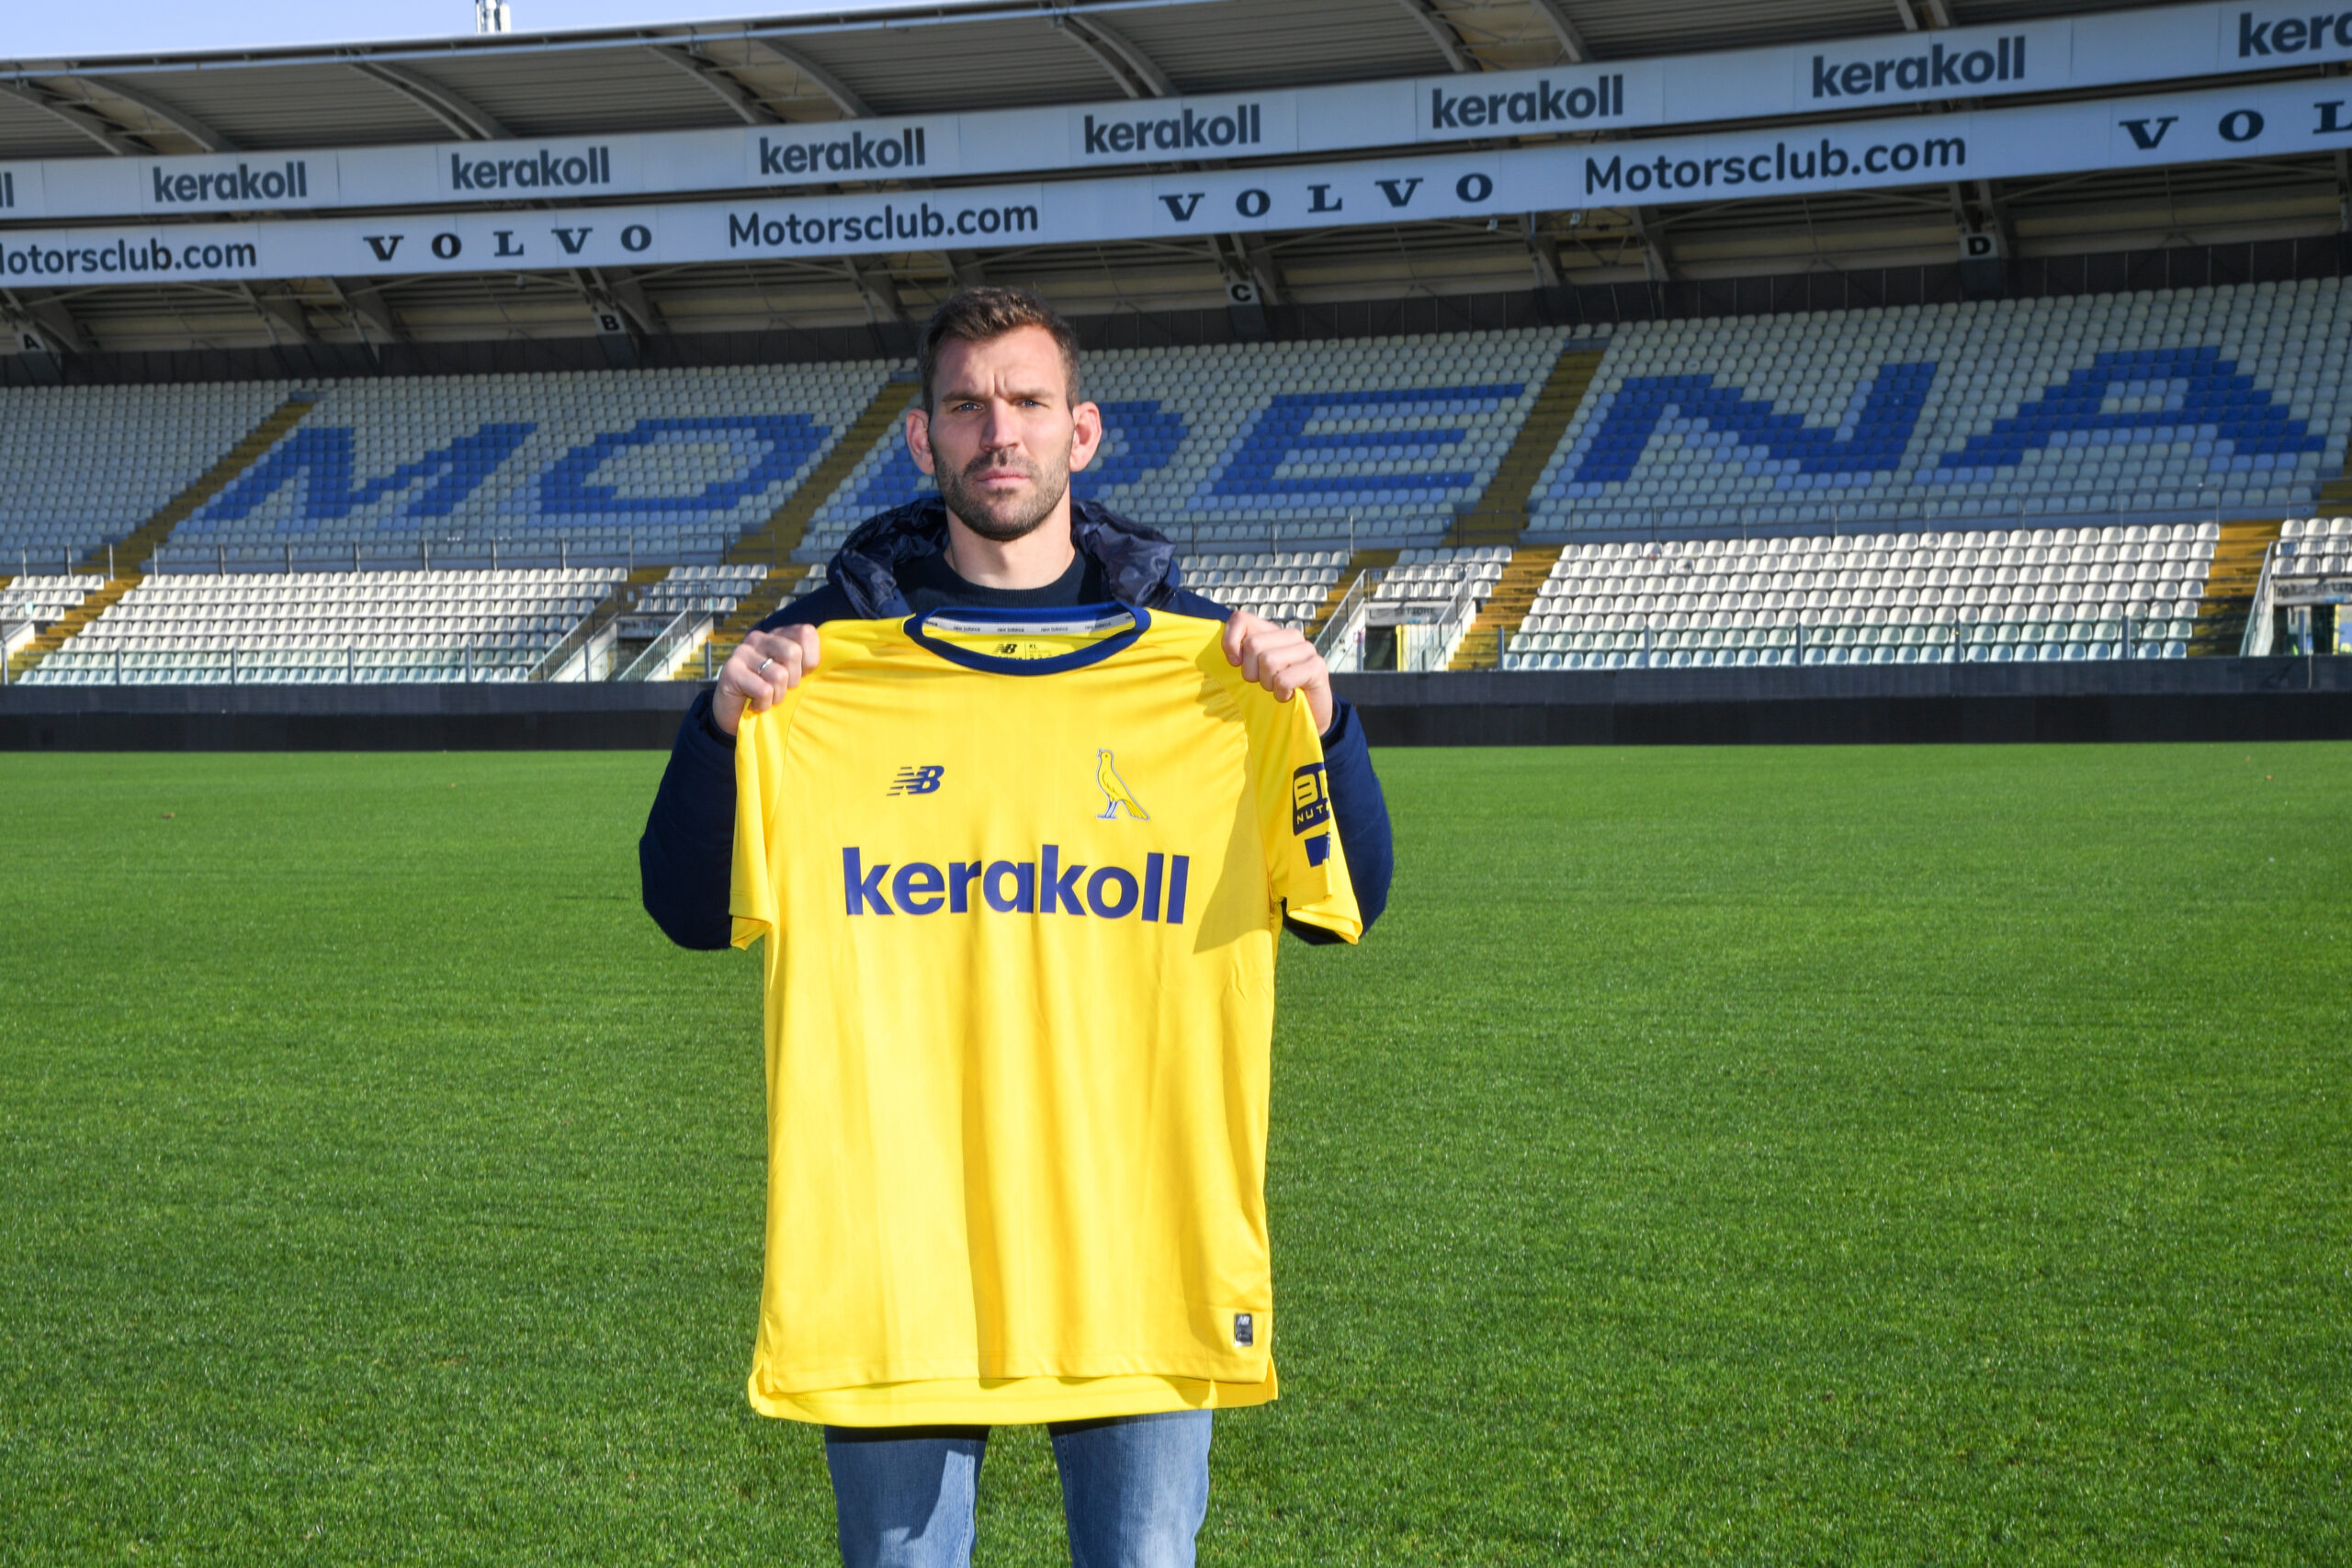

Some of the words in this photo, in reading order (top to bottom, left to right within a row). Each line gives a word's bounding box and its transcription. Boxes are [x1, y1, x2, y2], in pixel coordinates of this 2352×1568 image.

[1814, 36, 2026, 98] kerakoll
[1432, 74, 1623, 129] kerakoll
[1085, 104, 1261, 153] kerakoll
[451, 147, 610, 189] kerakoll
[760, 128, 926, 174] kerakoll
[1586, 138, 1966, 195] Motorsclub.com
[153, 162, 308, 202] kerakoll
[1159, 174, 1493, 222] VOLVO
[364, 224, 652, 262] VOLVO
[729, 203, 1038, 247] Motorsclub.com
[1968, 237, 1991, 255] D
[0, 238, 256, 275] otorsclub.com
[1231, 284, 1251, 302] C
[23, 333, 40, 350] A
[600, 315, 620, 331] B
[842, 844, 1190, 925] kerakoll
